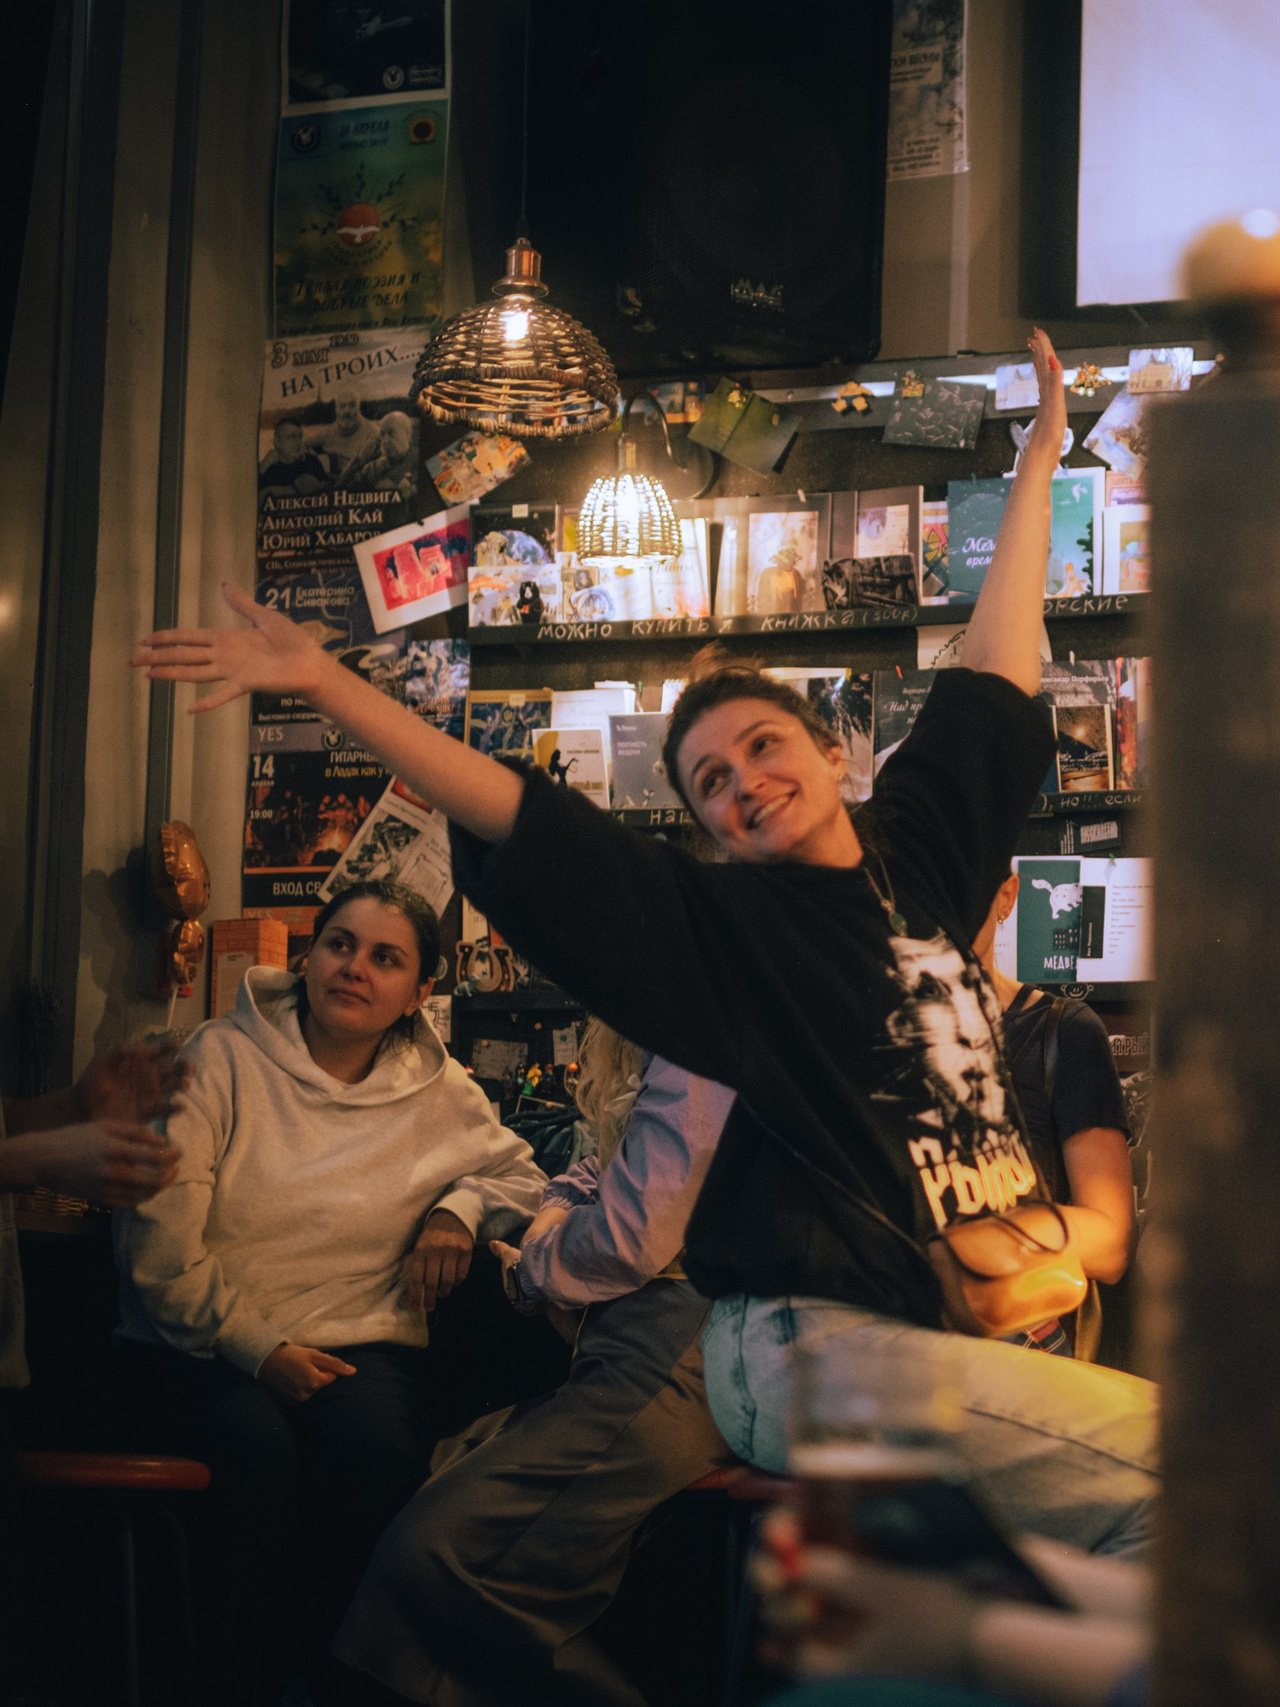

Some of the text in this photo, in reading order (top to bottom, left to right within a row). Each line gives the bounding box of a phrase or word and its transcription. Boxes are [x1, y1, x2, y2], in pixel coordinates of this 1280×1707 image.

[272, 341, 330, 369] 3 МАЯ
[281, 374, 315, 398] НА
[961, 536, 997, 554] Мел
[265, 587, 291, 609] 21
[258, 726, 284, 742] YES
[253, 754, 275, 778] 14
[330, 751, 378, 764] ГИТАРНЫ
[273, 880, 321, 898] ВХОД СВ
[1044, 954, 1077, 971] МЕДВЕ
